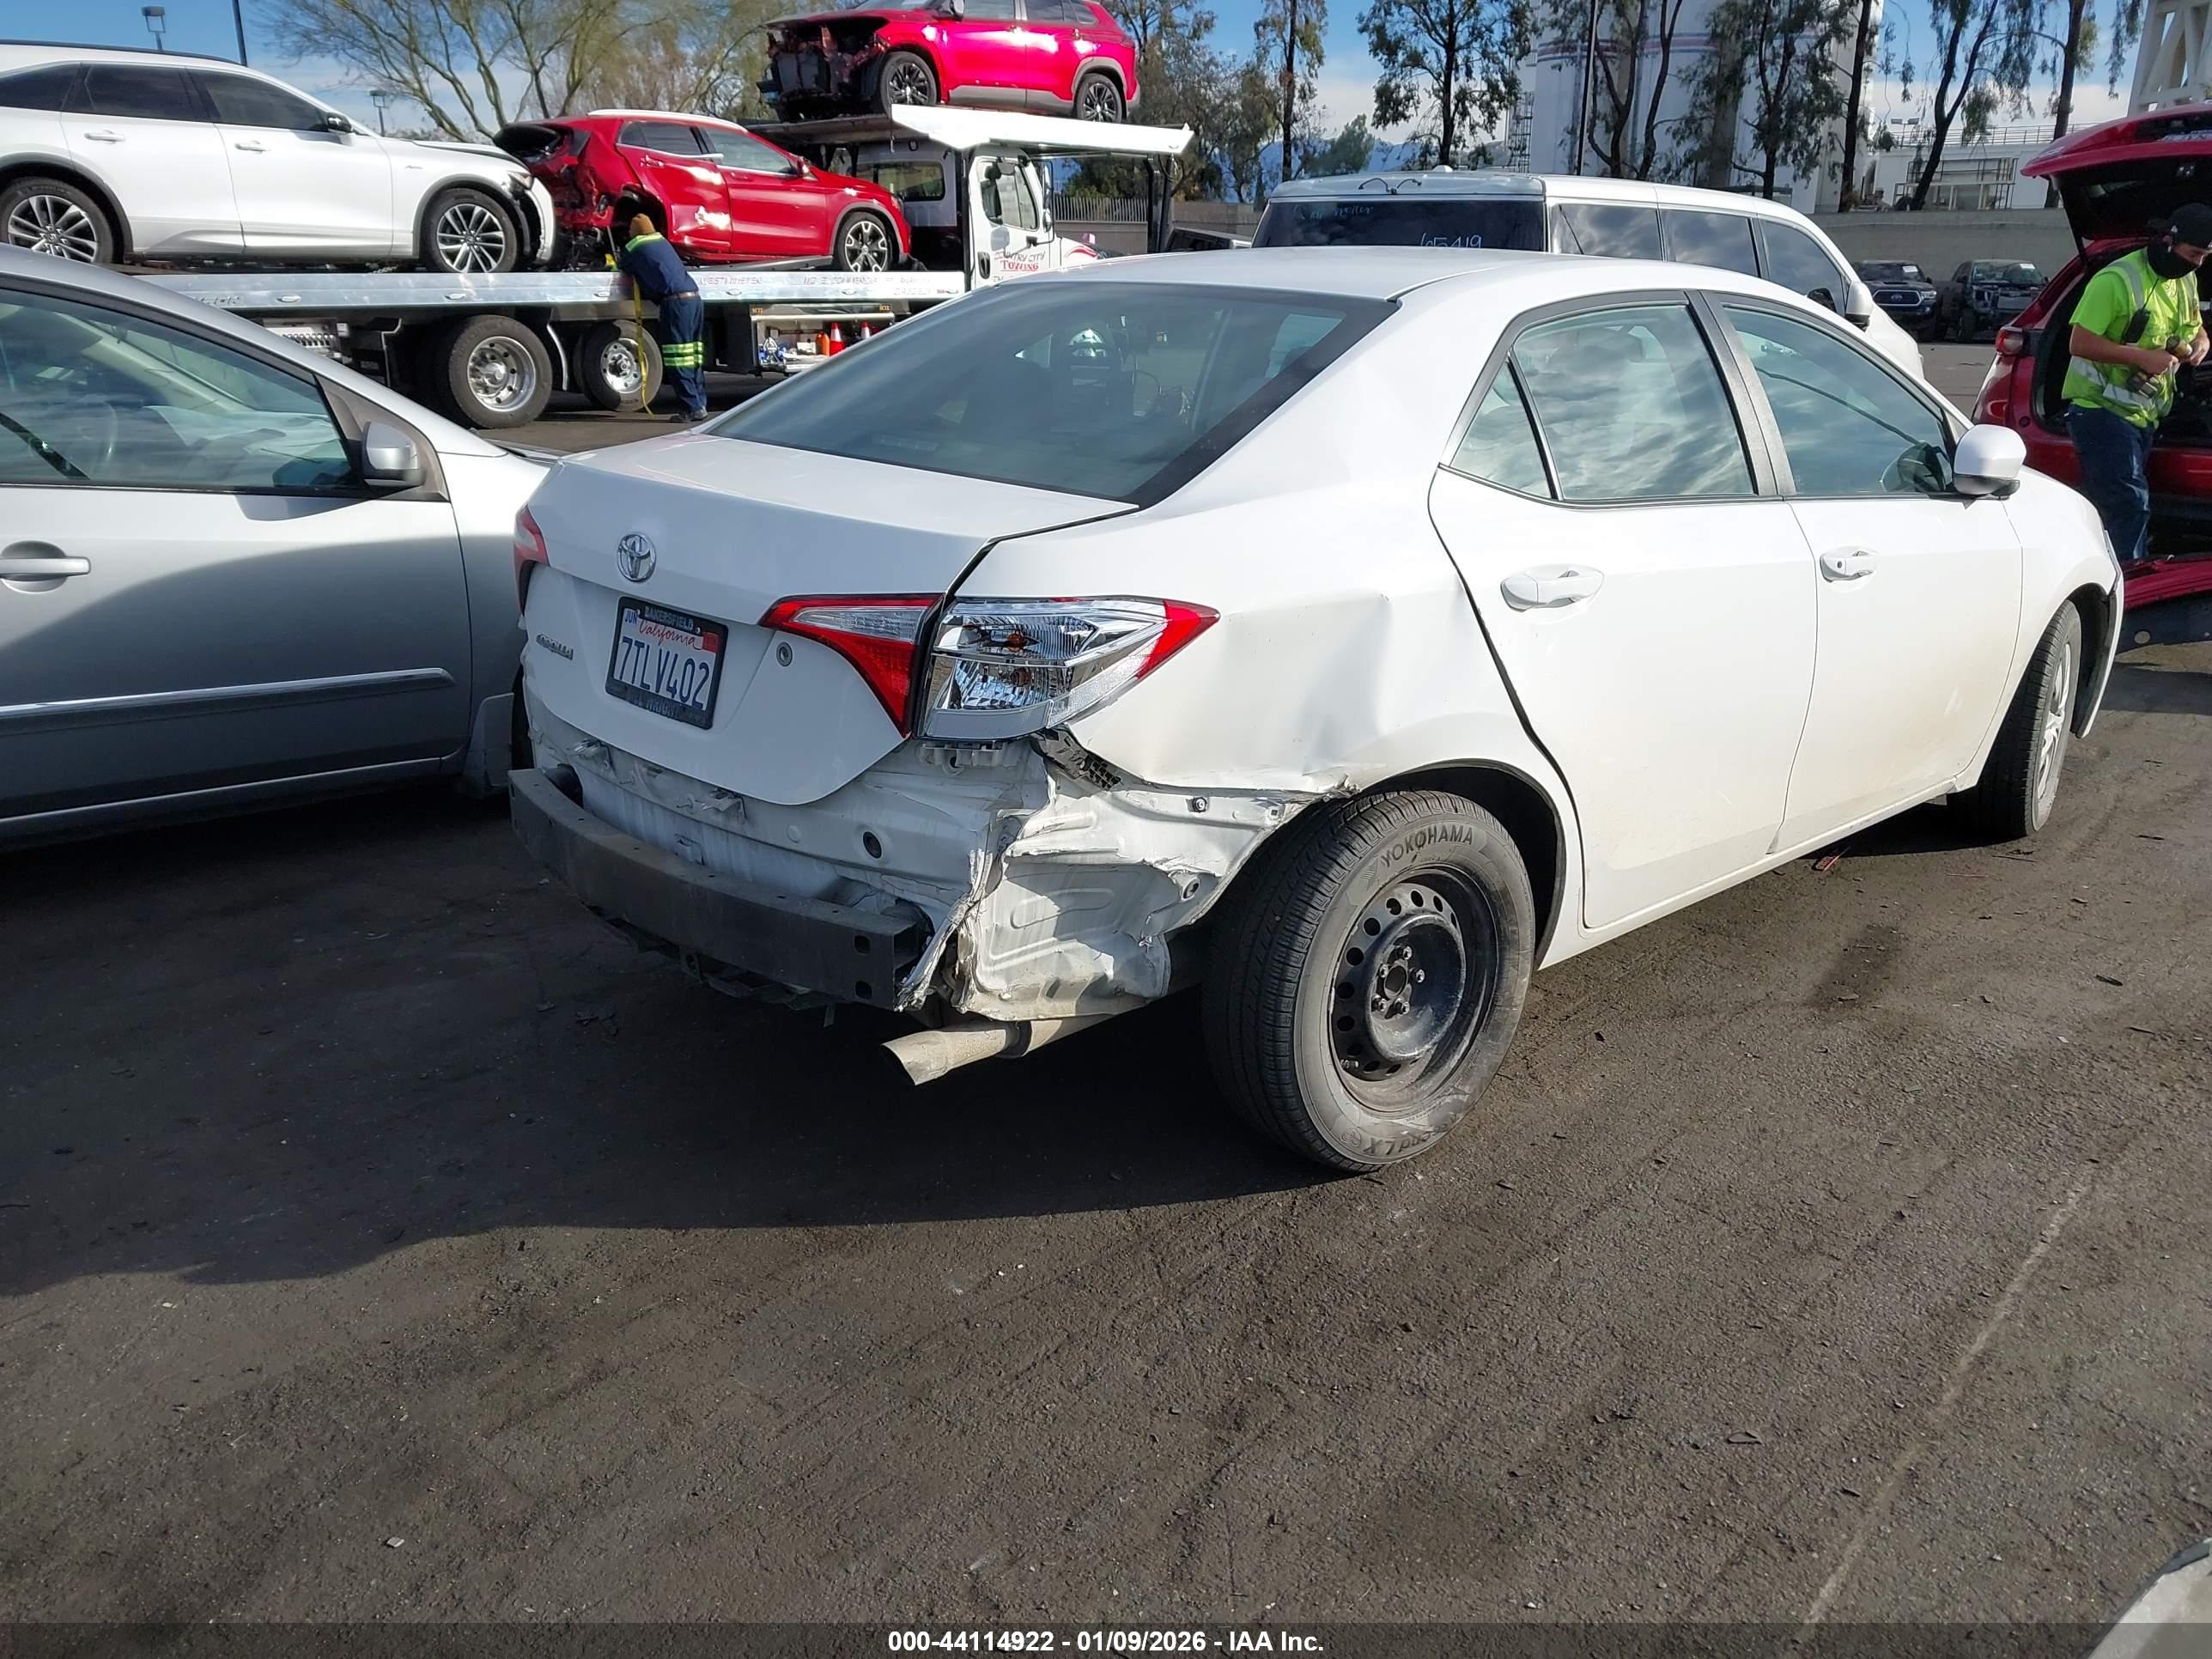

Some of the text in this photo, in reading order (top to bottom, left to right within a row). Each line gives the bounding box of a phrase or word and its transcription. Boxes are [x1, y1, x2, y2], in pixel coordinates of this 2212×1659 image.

[624, 610, 638, 625] JUN
[639, 619, 703, 651] California
[619, 635, 711, 709] 7TLV402
[1380, 824, 1474, 868] YOKOHAMA
